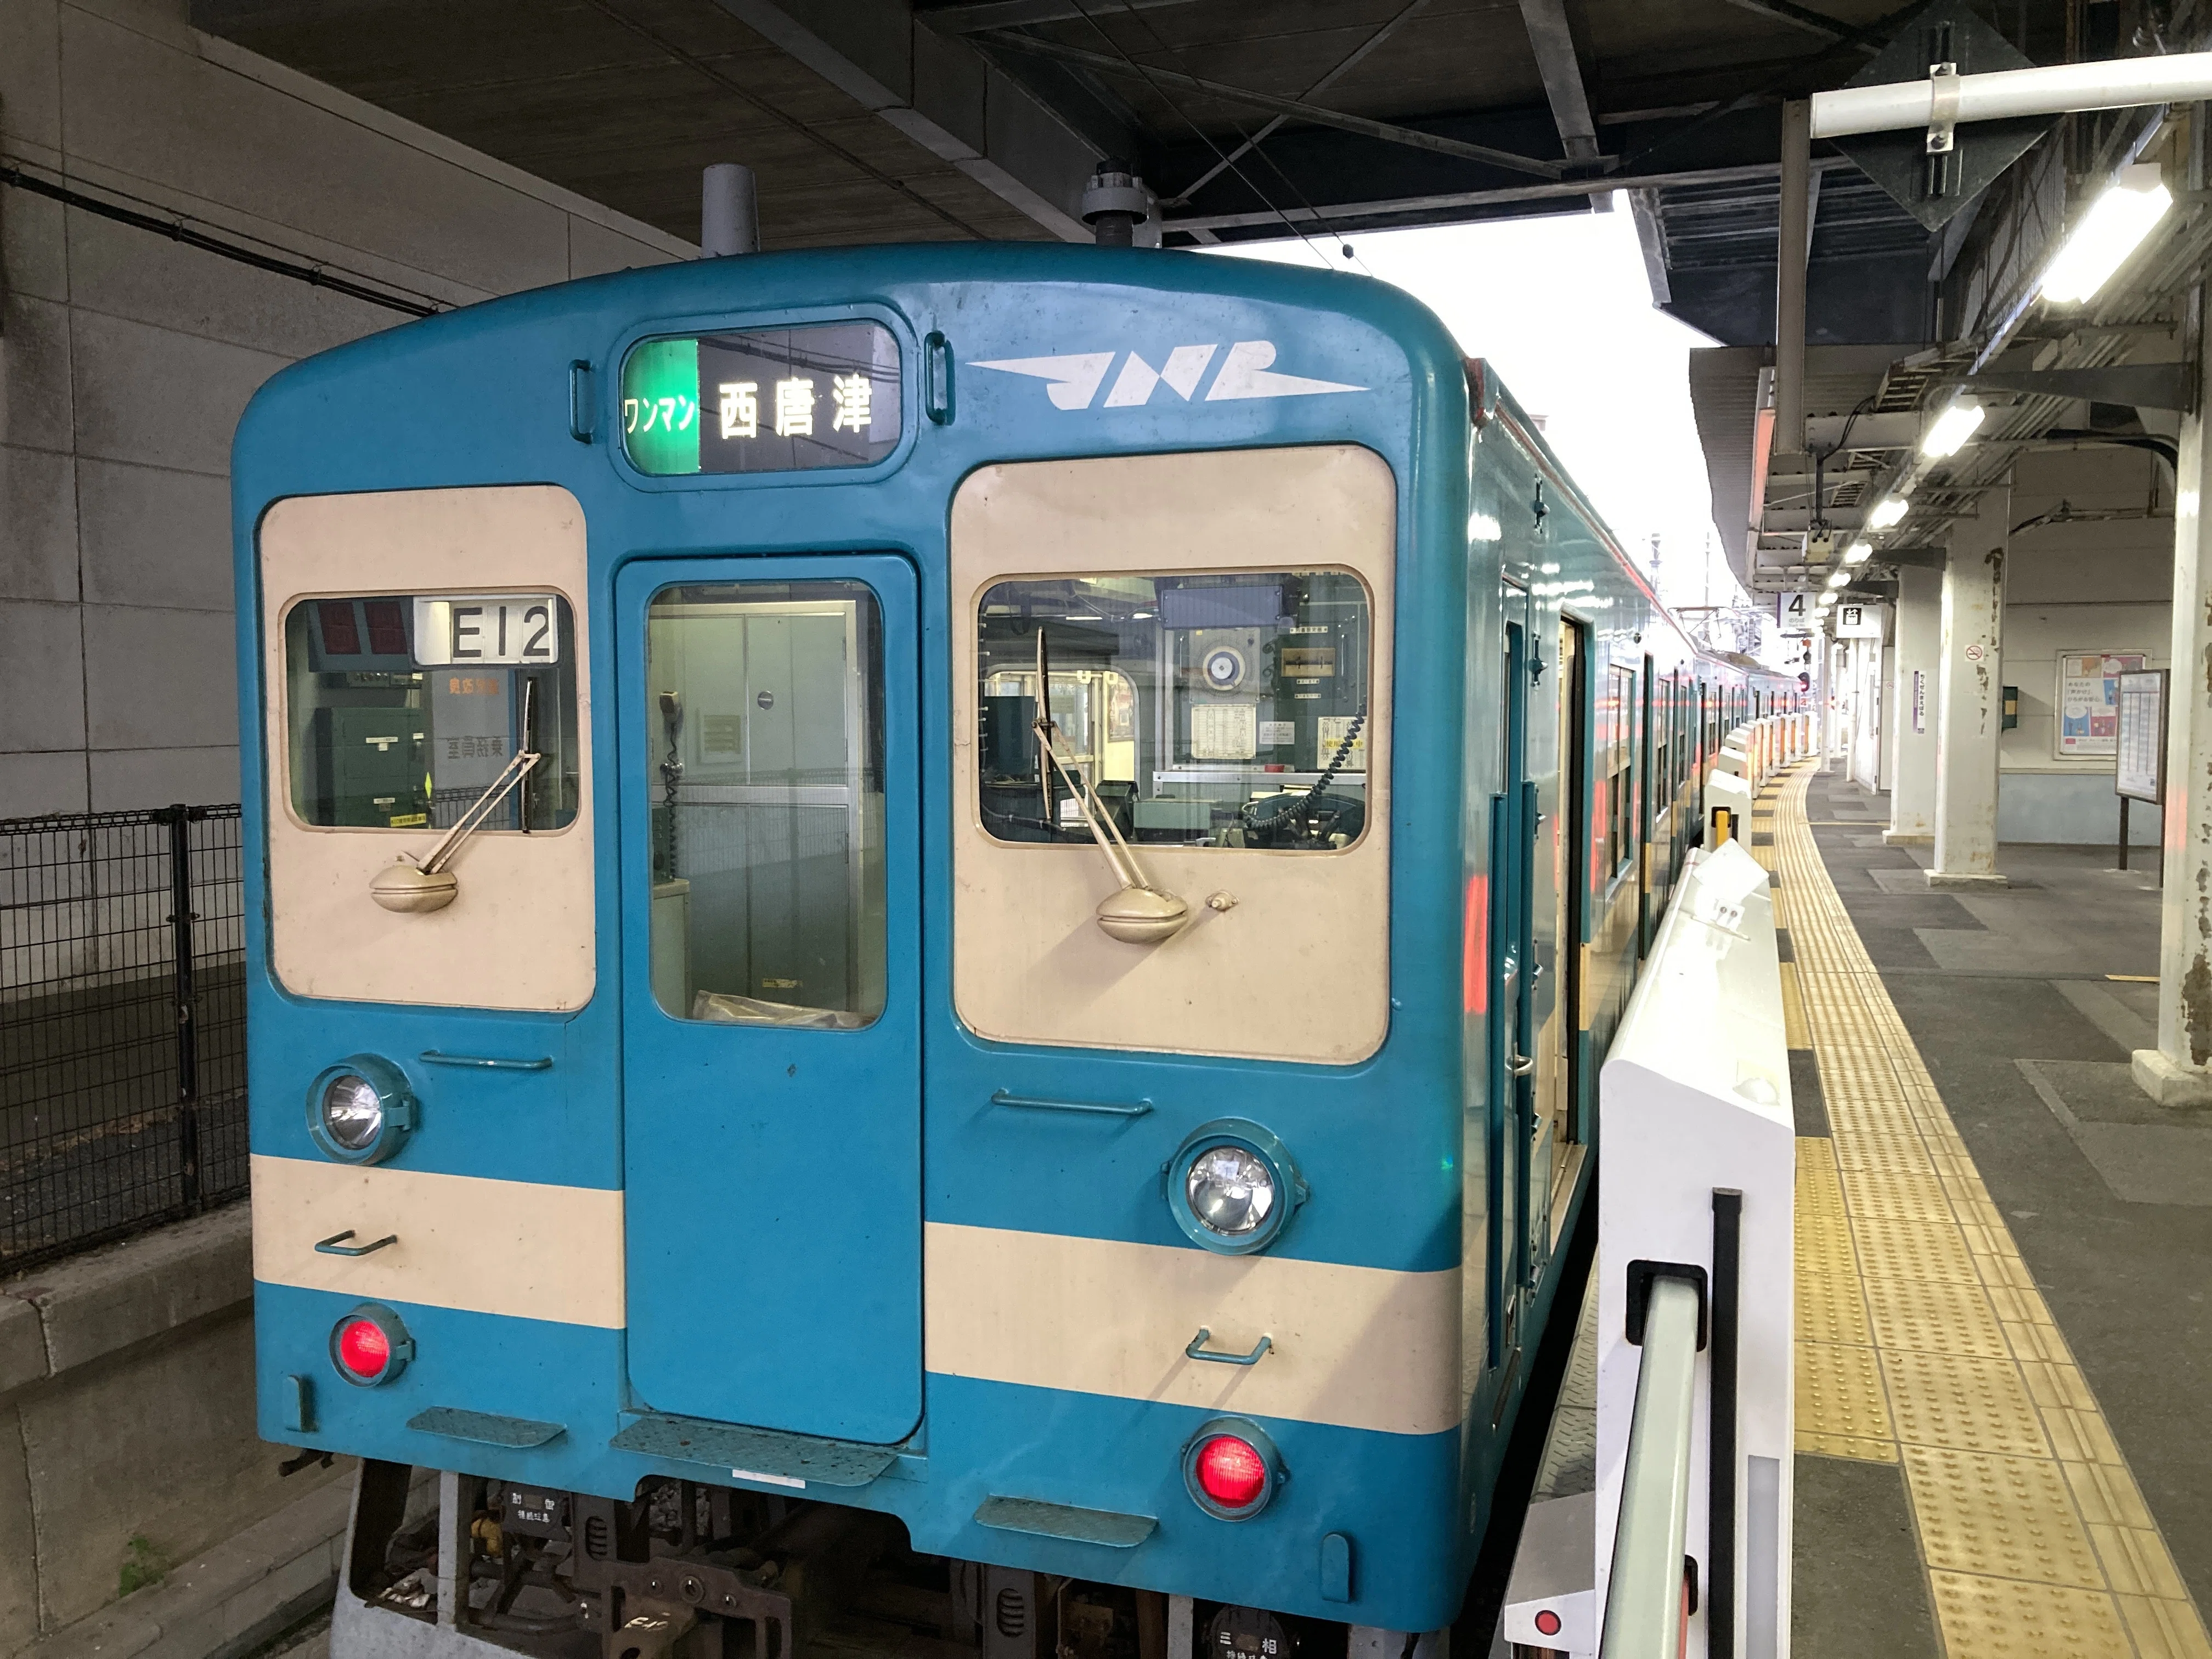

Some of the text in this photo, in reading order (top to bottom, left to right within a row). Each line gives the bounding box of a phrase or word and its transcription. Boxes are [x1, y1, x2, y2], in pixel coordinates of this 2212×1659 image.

[966, 340, 1371, 410] JNR
[624, 394, 694, 435] ワンマン
[719, 374, 872, 439] 西唐津
[453, 605, 550, 658] E12
[1788, 595, 1806, 616] 4
